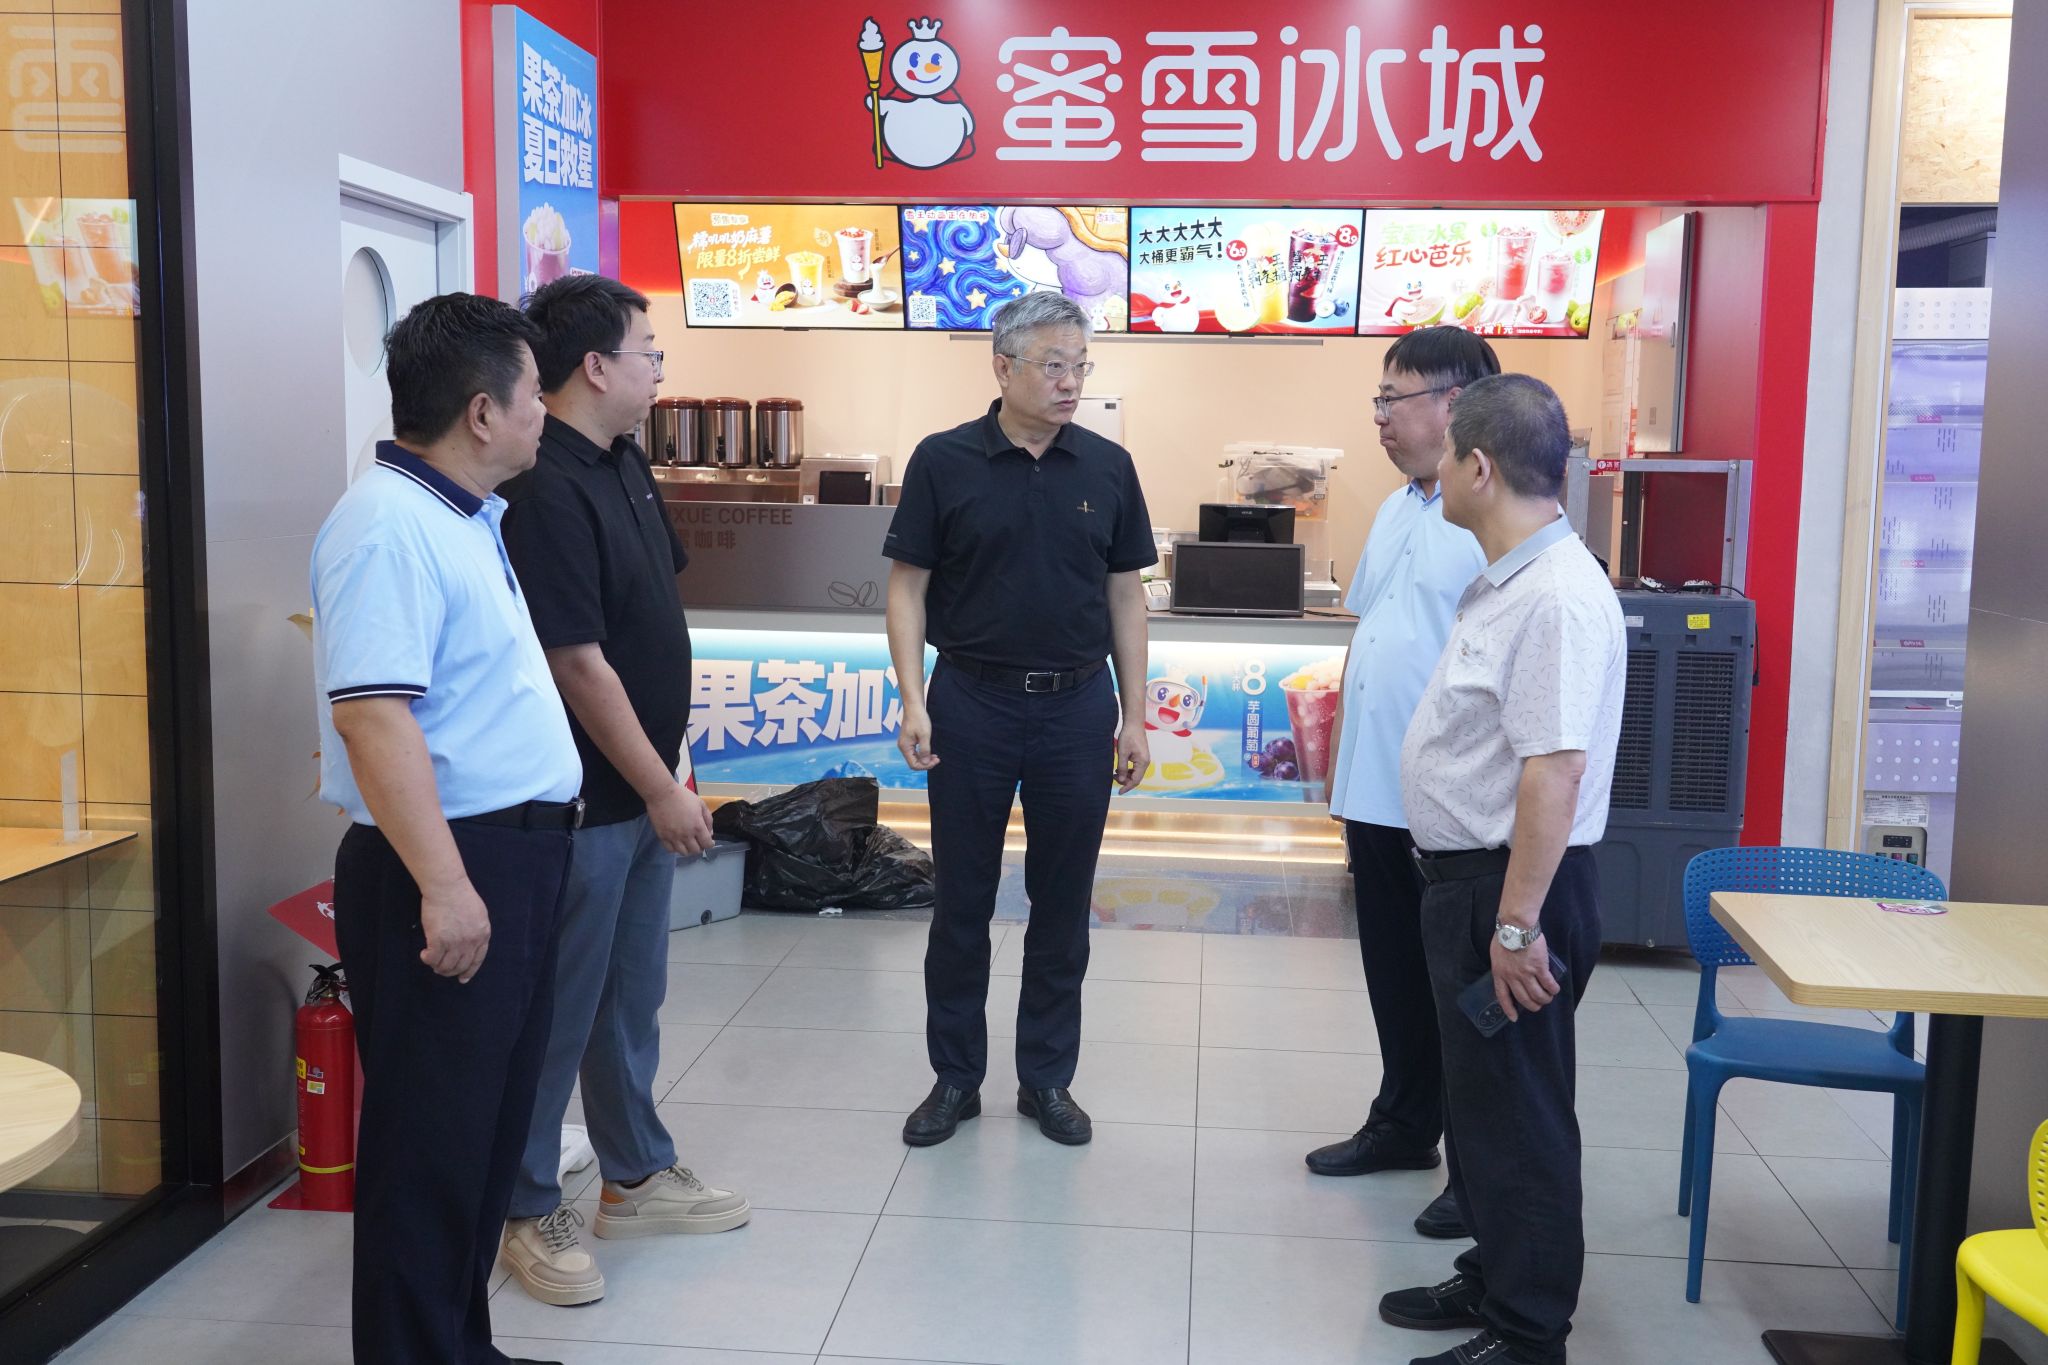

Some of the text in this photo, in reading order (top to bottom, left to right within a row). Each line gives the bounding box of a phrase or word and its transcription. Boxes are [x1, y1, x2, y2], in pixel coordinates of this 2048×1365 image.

[522, 40, 592, 140] 果茶加冰
[996, 24, 1545, 162] 蜜雪冰城
[522, 112, 593, 189] 夏日救星
[1139, 216, 1222, 244] 大大大大大
[1374, 241, 1473, 270] 红心芭乐
[718, 508, 793, 525] COFFEE
[1241, 658, 1266, 696] 8
